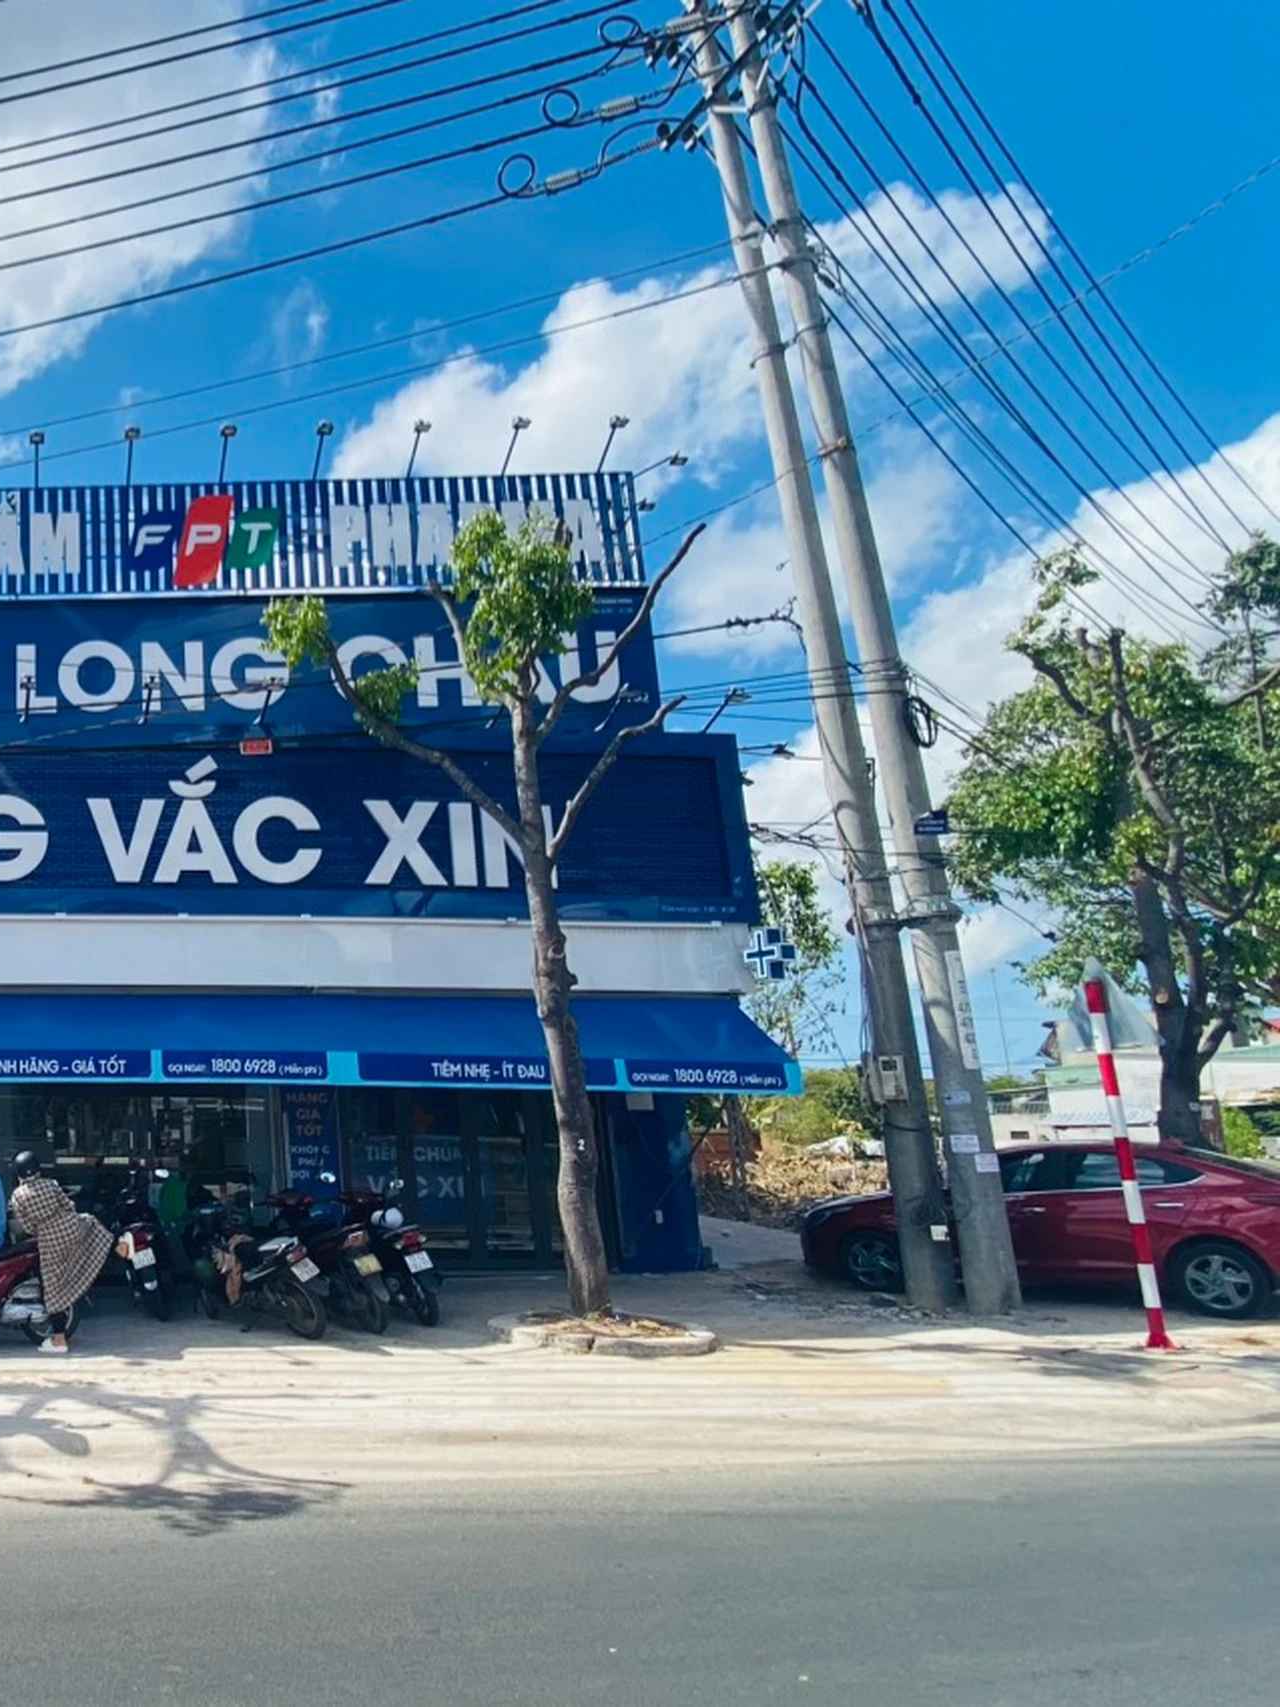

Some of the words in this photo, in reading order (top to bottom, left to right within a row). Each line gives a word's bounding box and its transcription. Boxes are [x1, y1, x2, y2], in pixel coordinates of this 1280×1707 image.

[329, 498, 606, 569] PHAA
[14, 635, 291, 718] LONG
[85, 754, 323, 885] VẮC
[362, 798, 559, 889] XIN
[71, 1056, 97, 1074] GIÁ
[98, 1053, 127, 1074] TỐT
[211, 1058, 242, 1073] 1800
[243, 1058, 277, 1074] 6928
[431, 1058, 462, 1078] TIÊM
[464, 1062, 491, 1082] NHẸ
[502, 1059, 515, 1078] ÍT
[517, 1064, 546, 1079] ĐAU
[674, 1068, 705, 1084] 1800
[706, 1069, 738, 1084] 6928
[577, 1138, 586, 1151] 2
